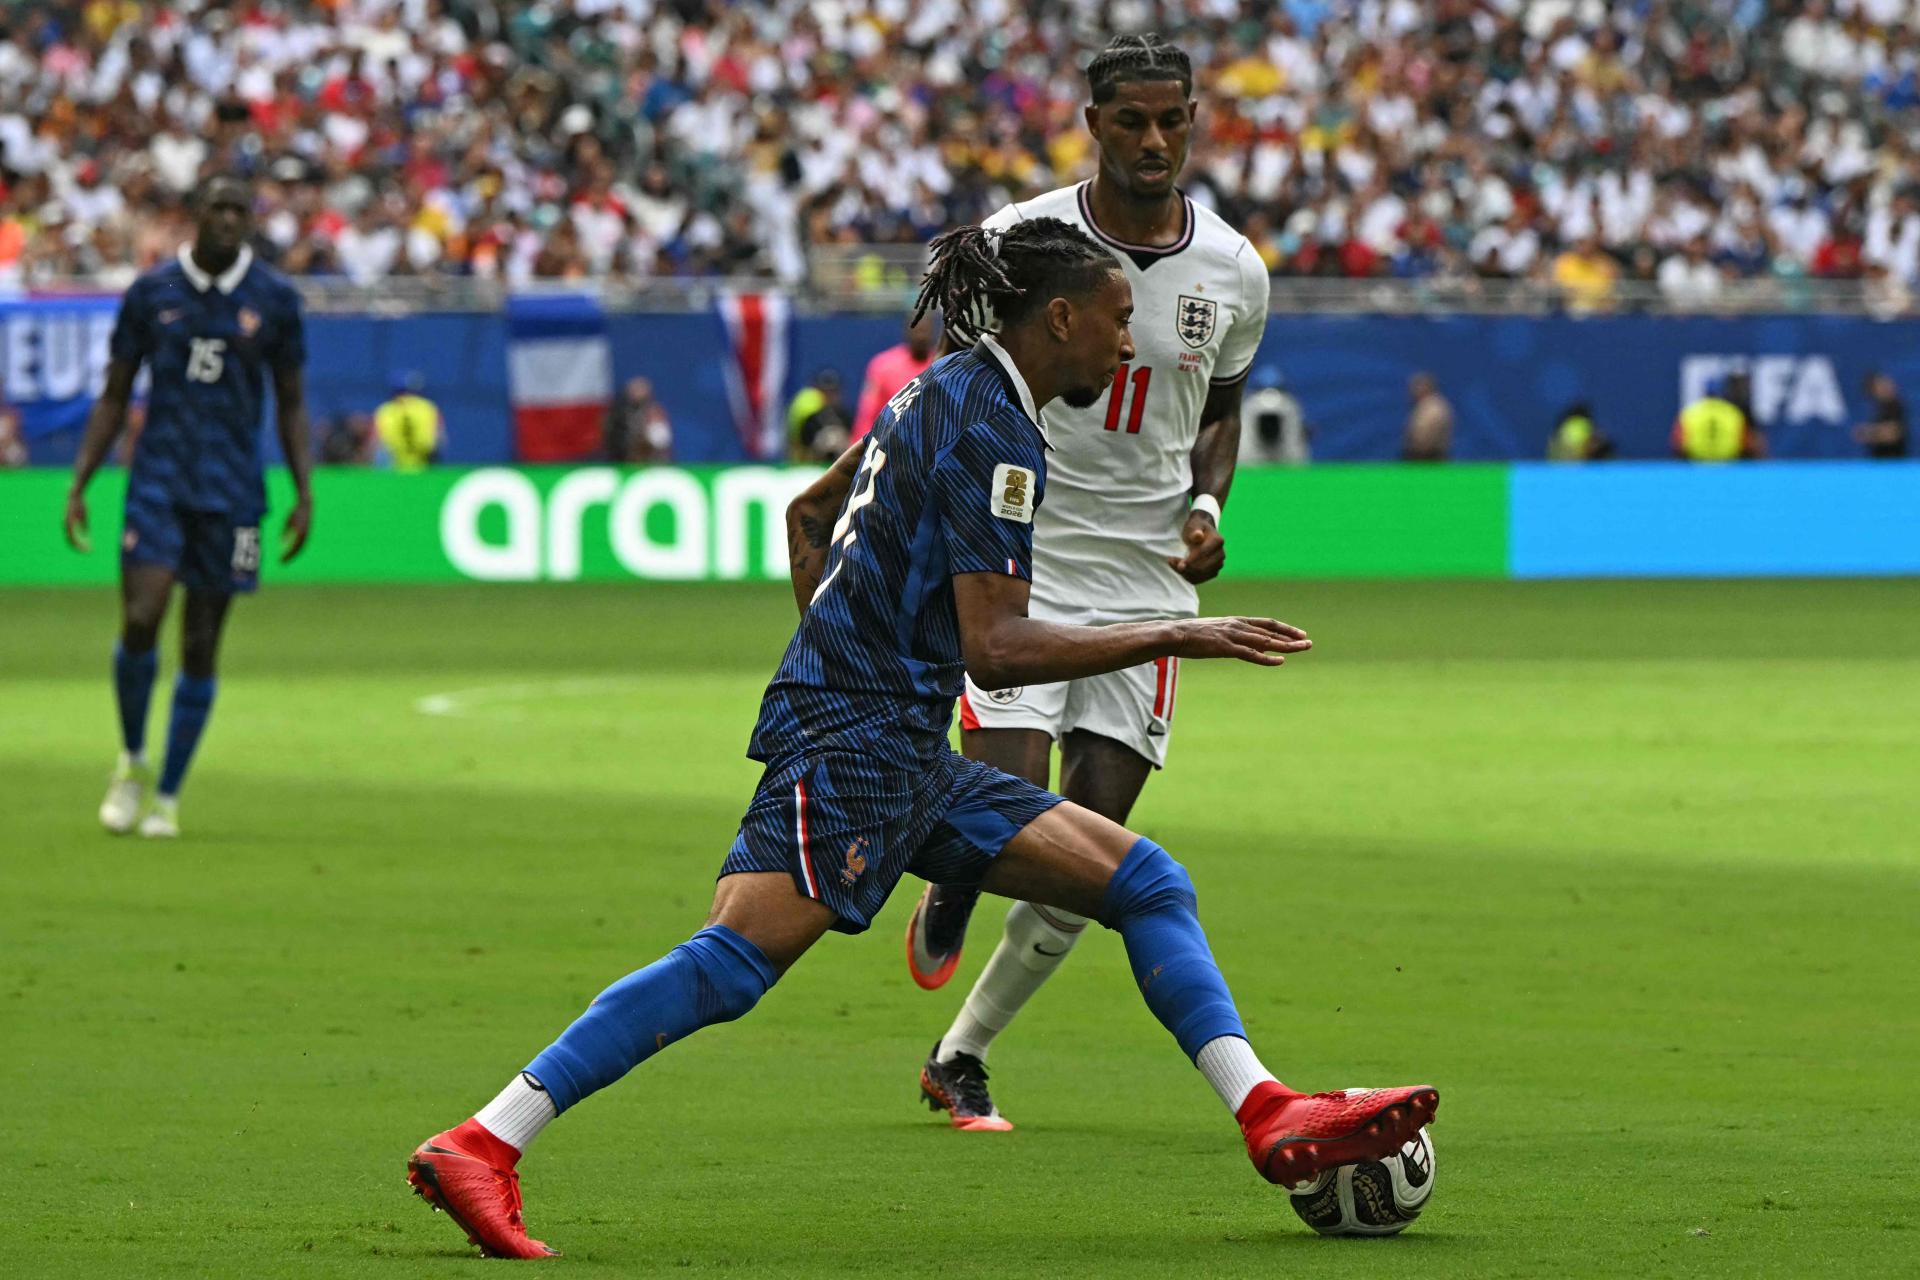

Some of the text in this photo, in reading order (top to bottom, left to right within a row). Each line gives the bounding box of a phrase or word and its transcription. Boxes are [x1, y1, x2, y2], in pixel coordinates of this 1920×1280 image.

[186, 337, 227, 384] 15
[1680, 354, 1846, 425] FFA
[1103, 362, 1152, 434] 11
[440, 466, 832, 581] aram
[1001, 509, 1023, 517] 2026
[231, 527, 260, 571] 15
